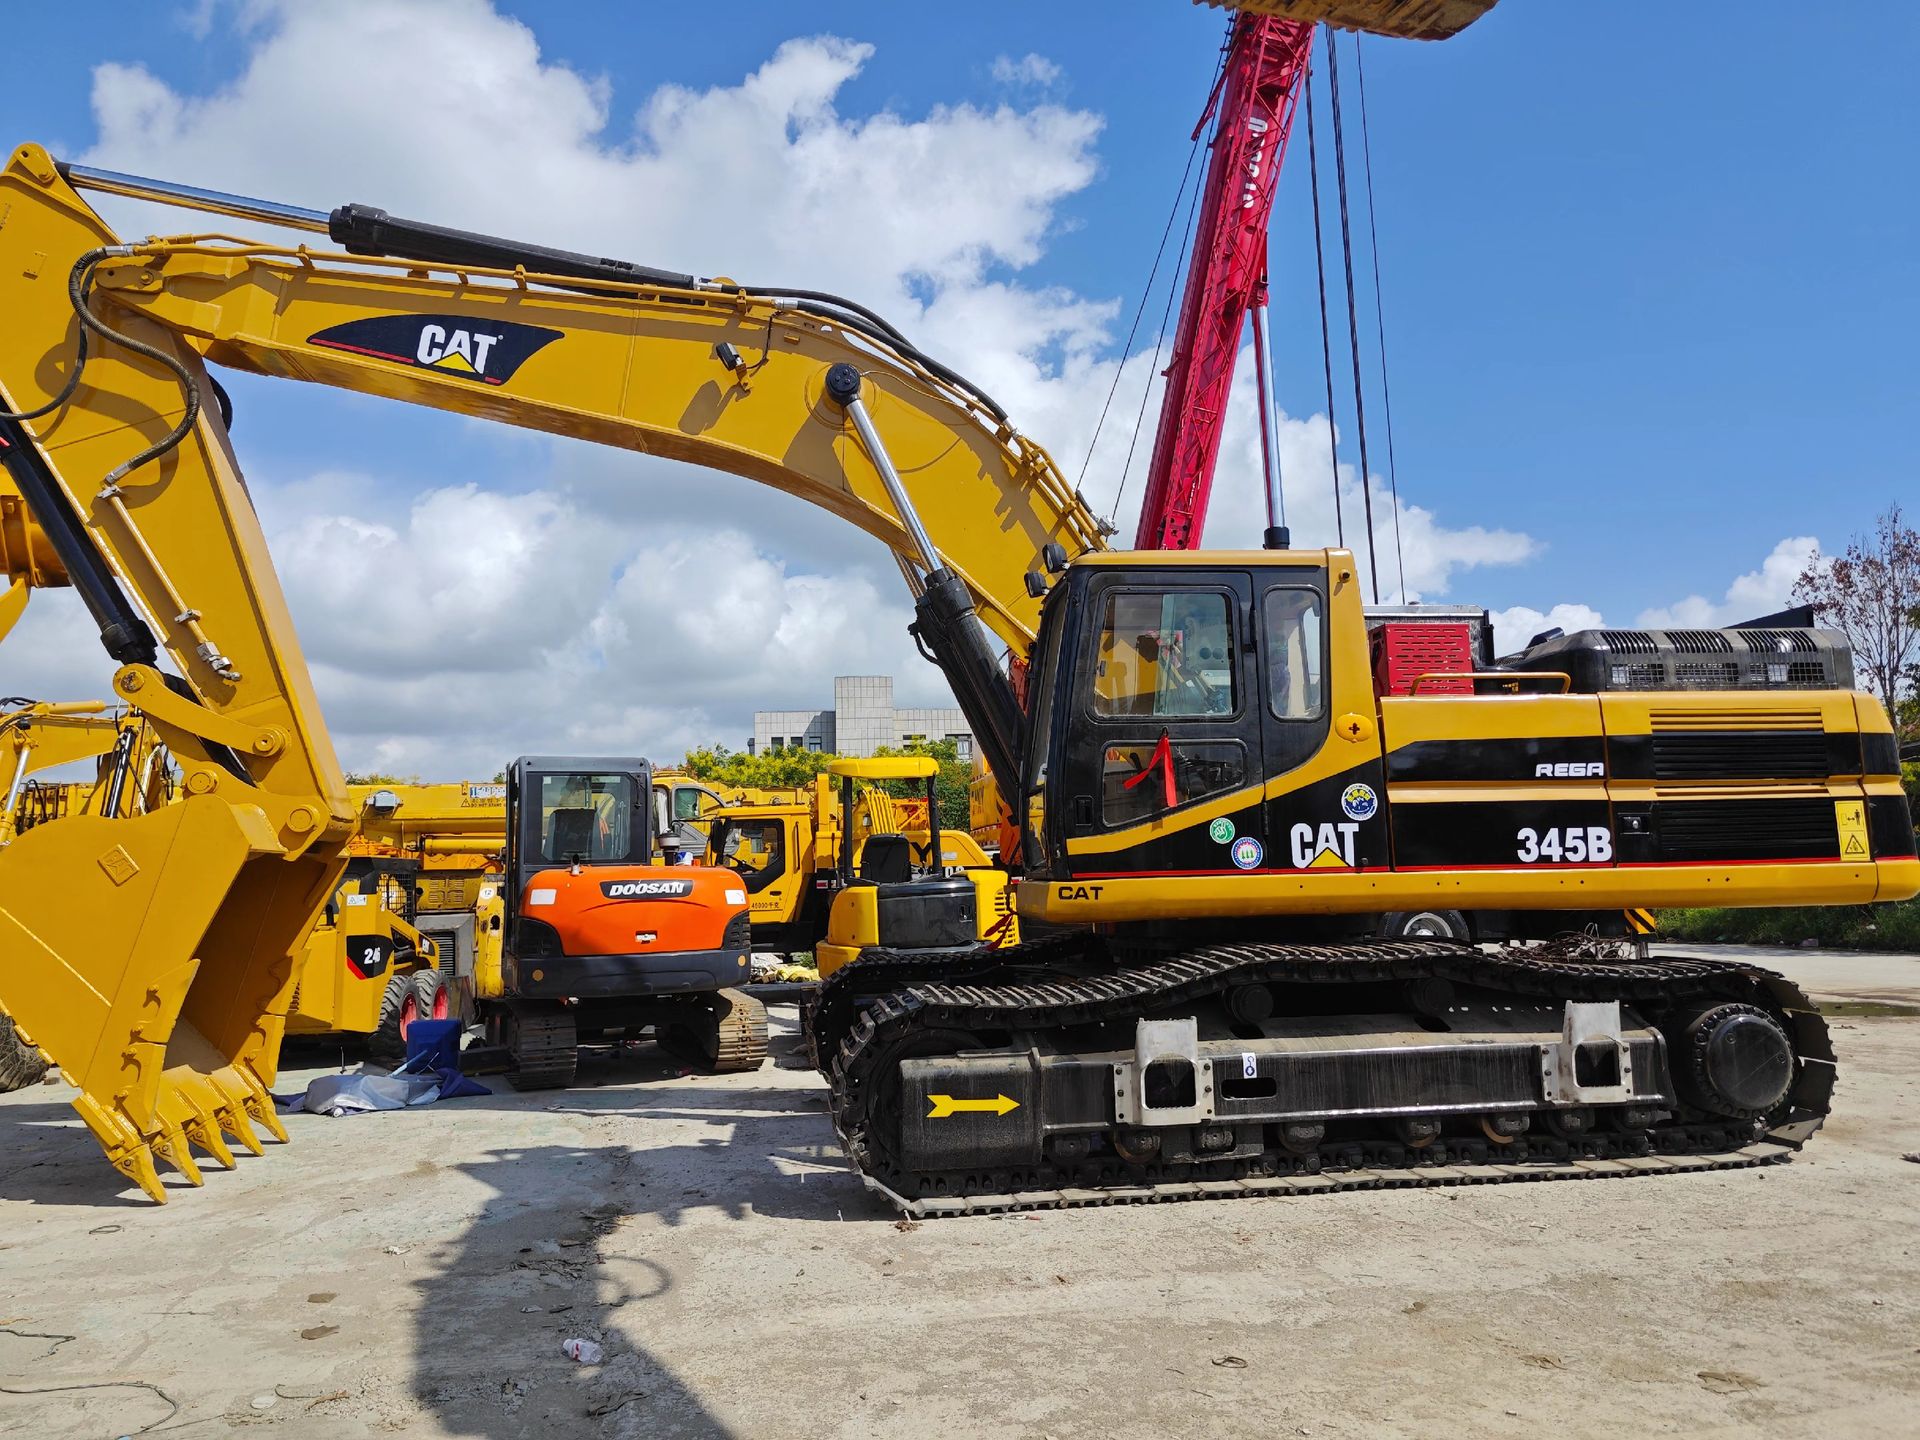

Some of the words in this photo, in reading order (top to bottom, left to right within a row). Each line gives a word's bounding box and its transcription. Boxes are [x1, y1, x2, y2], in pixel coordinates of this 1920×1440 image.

[417, 324, 498, 375] CAT
[1535, 762, 1605, 777] REGA
[1290, 823, 1359, 869] CAT
[1517, 827, 1613, 863] 345B
[609, 881, 685, 896] DOOSAN
[1058, 886, 1104, 900] CAT
